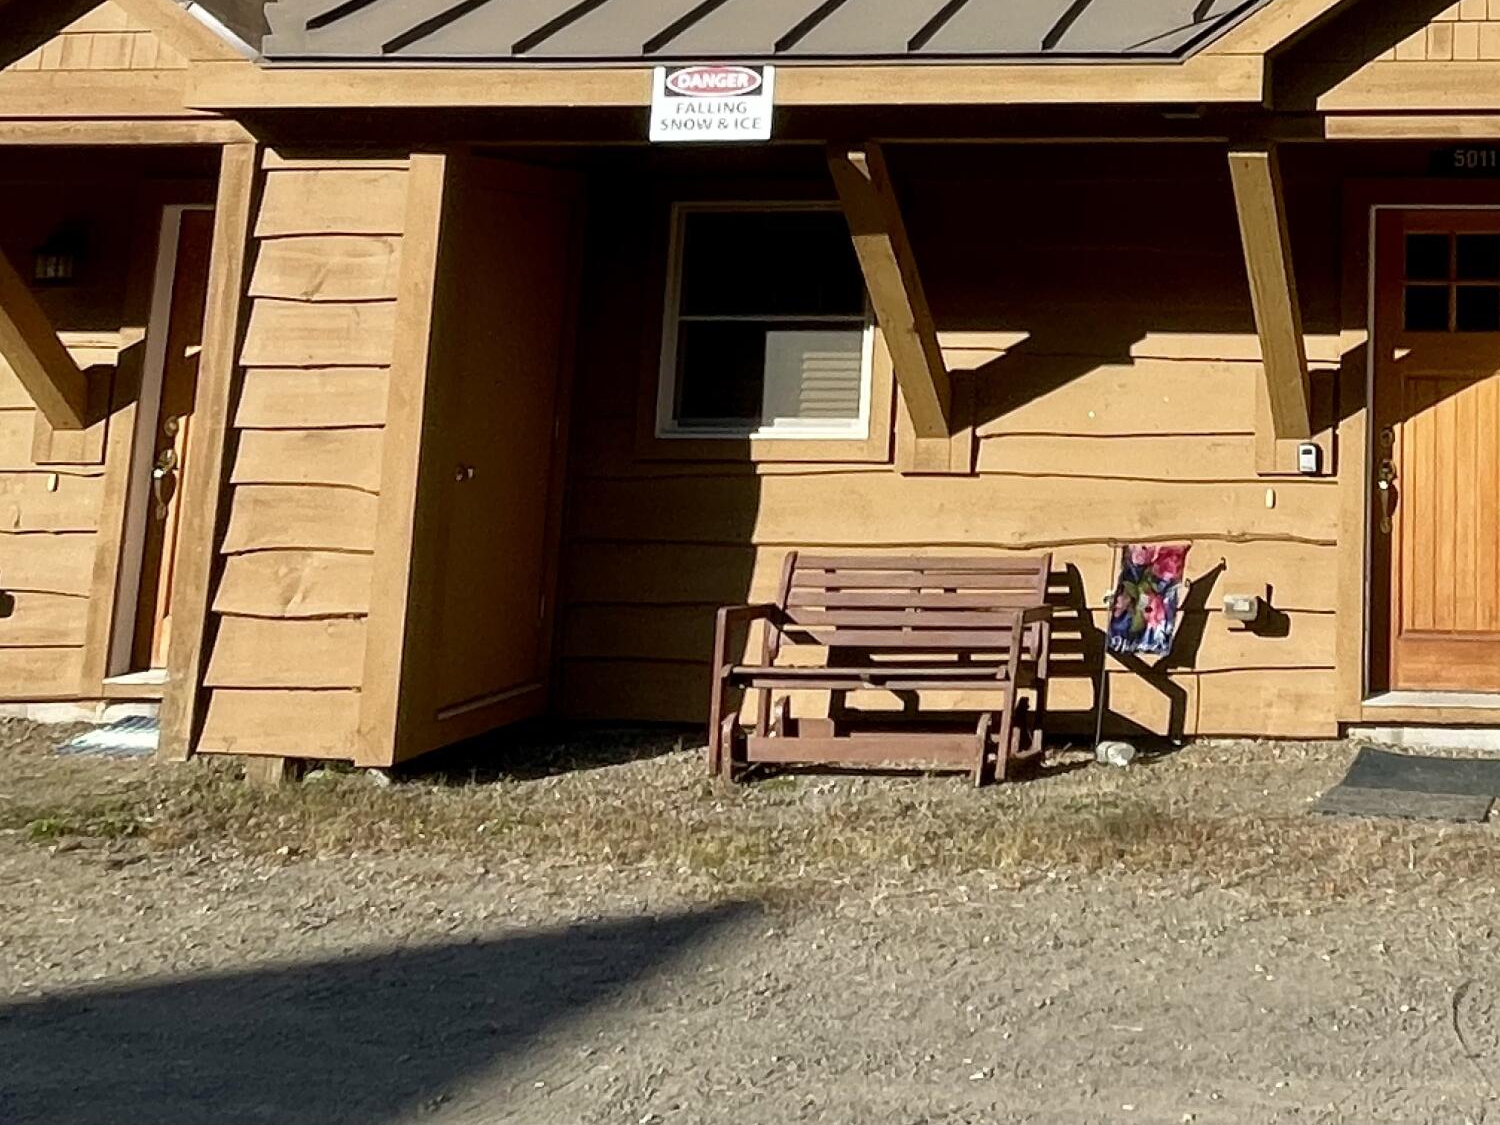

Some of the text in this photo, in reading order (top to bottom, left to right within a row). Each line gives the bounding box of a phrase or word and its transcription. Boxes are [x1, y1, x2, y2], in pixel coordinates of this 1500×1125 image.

[678, 73, 749, 88] DANGER
[676, 102, 747, 114] FALLING
[660, 117, 761, 130] SNOW & ICE
[1454, 149, 1496, 167] 5011
